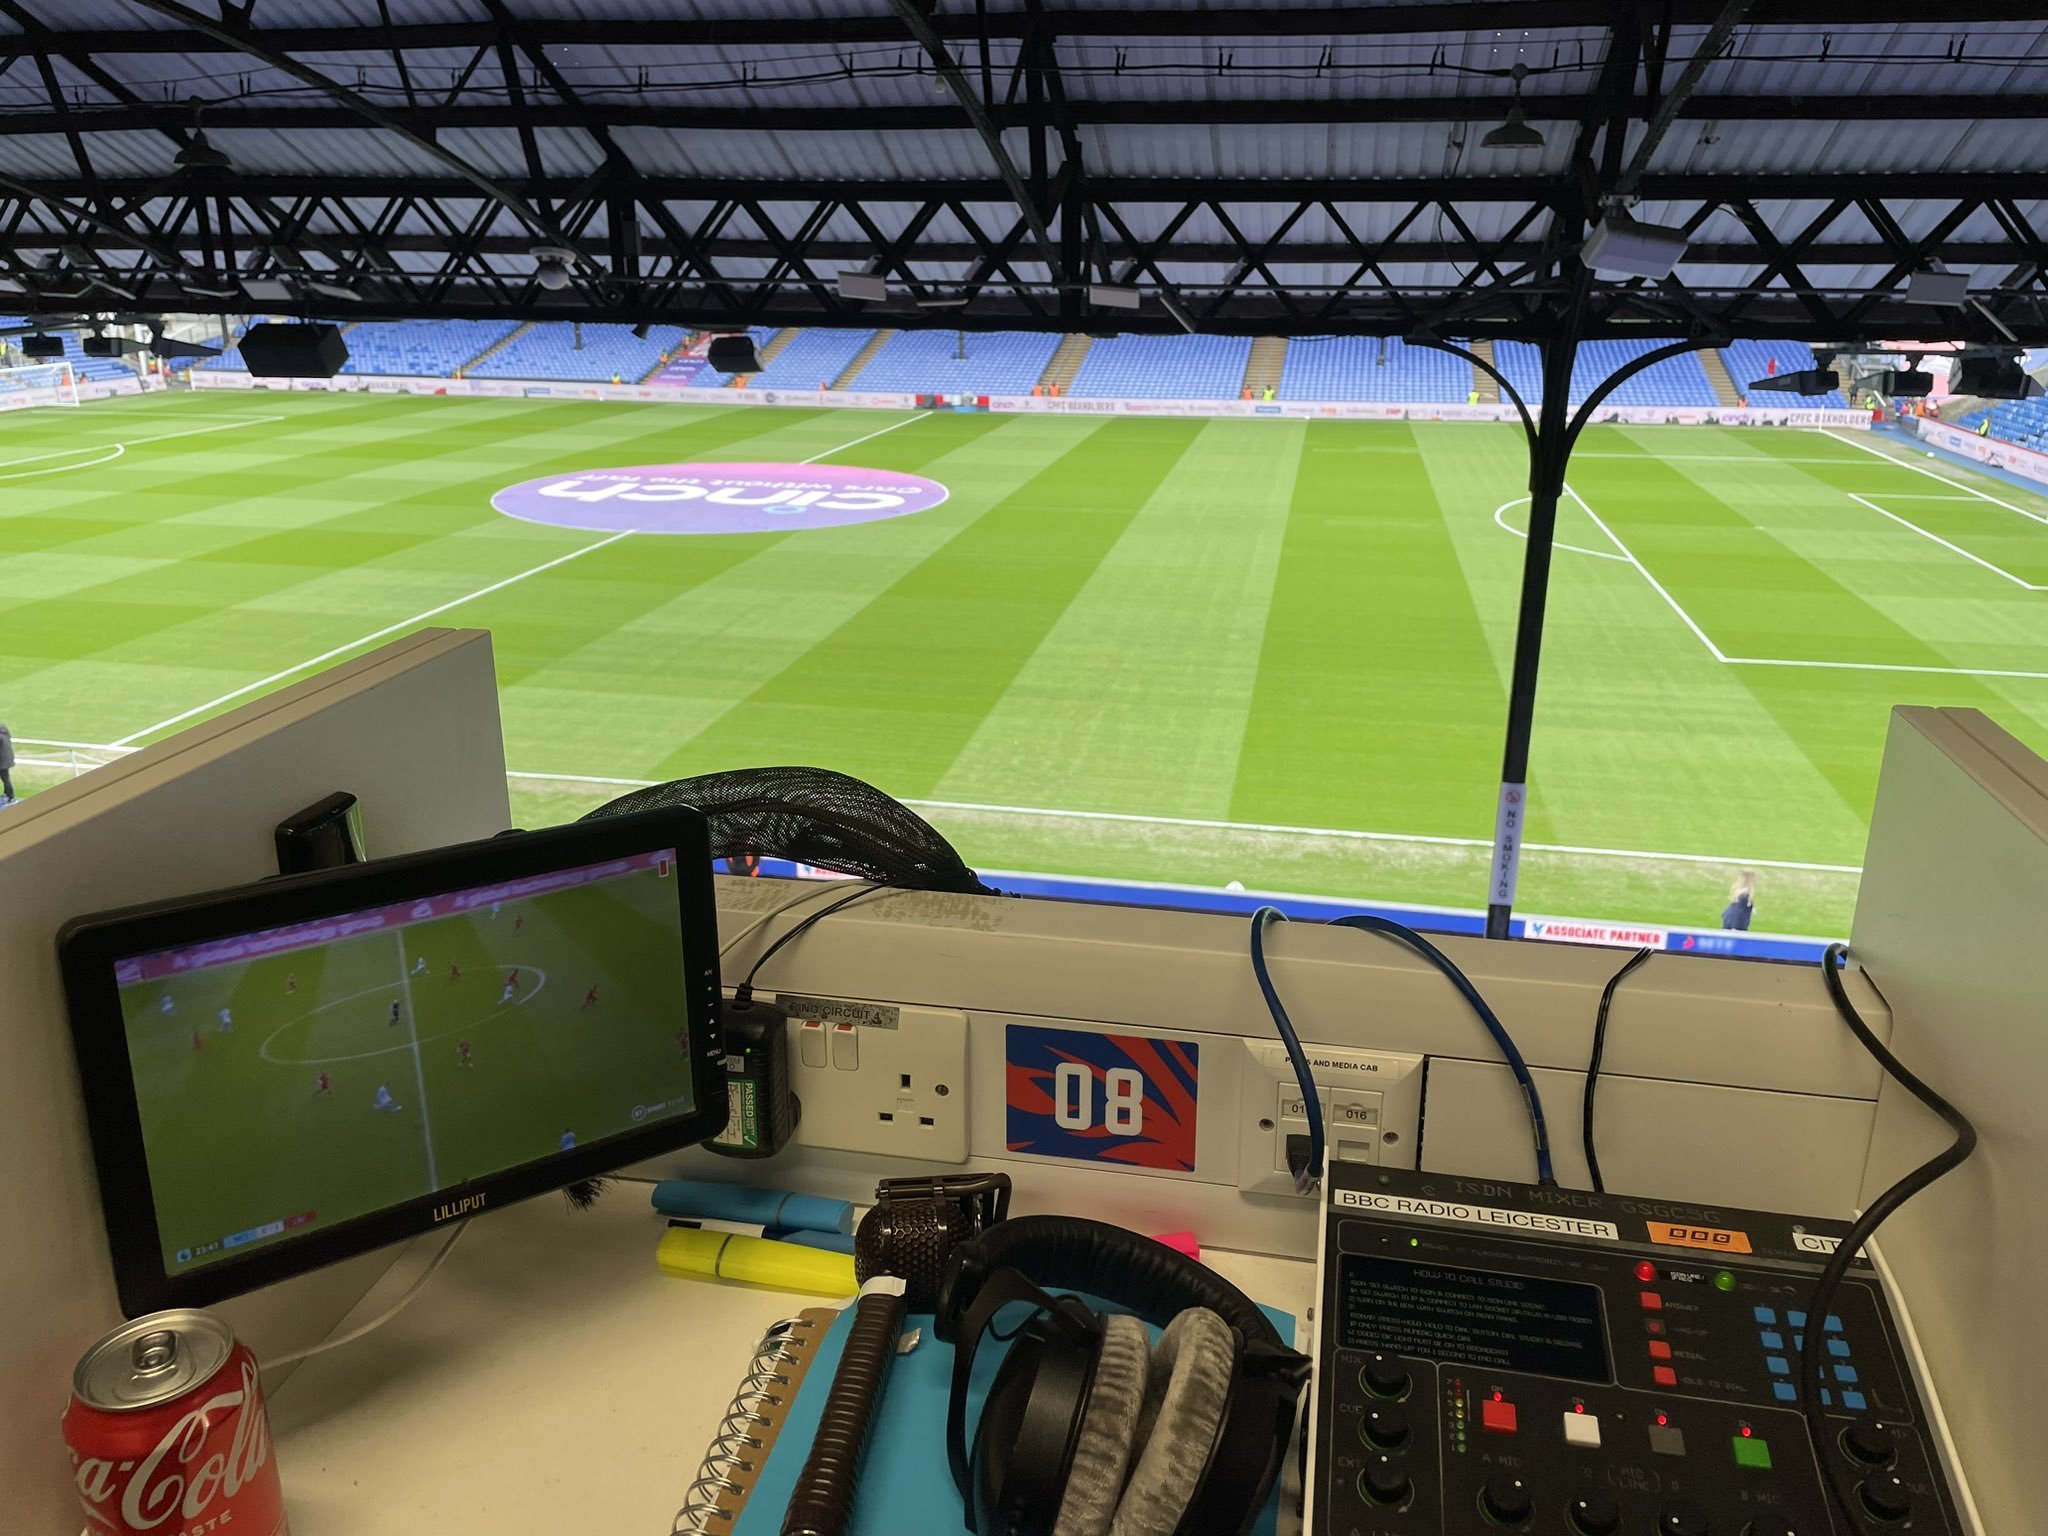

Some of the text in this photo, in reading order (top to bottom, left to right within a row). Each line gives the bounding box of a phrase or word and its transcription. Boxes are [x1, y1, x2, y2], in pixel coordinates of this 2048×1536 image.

[648, 477, 699, 485] the
[709, 479, 833, 490] without
[539, 480, 904, 514] cinch
[1498, 810, 1516, 898] NO SMOKING
[1545, 924, 1661, 945] ASSOCIATE PARTNER
[822, 1006, 870, 1019] CIRCUIT
[1313, 1059, 1330, 1068] AND
[1332, 1061, 1358, 1070] MEDIA
[1360, 1063, 1379, 1072] CAB
[745, 1082, 754, 1117] PASSED
[1055, 1062, 1143, 1136] 08
[1346, 1110, 1367, 1120] 016
[1455, 1181, 1512, 1199] ISDN
[1529, 1190, 1604, 1208] MIXER
[433, 1192, 487, 1222] LILLIPUT
[1343, 1193, 1609, 1236] BBC RADIO LEICESTER
[1413, 1269, 1441, 1279] HOW
[1444, 1272, 1456, 1281] TO
[1459, 1274, 1484, 1286] CALL
